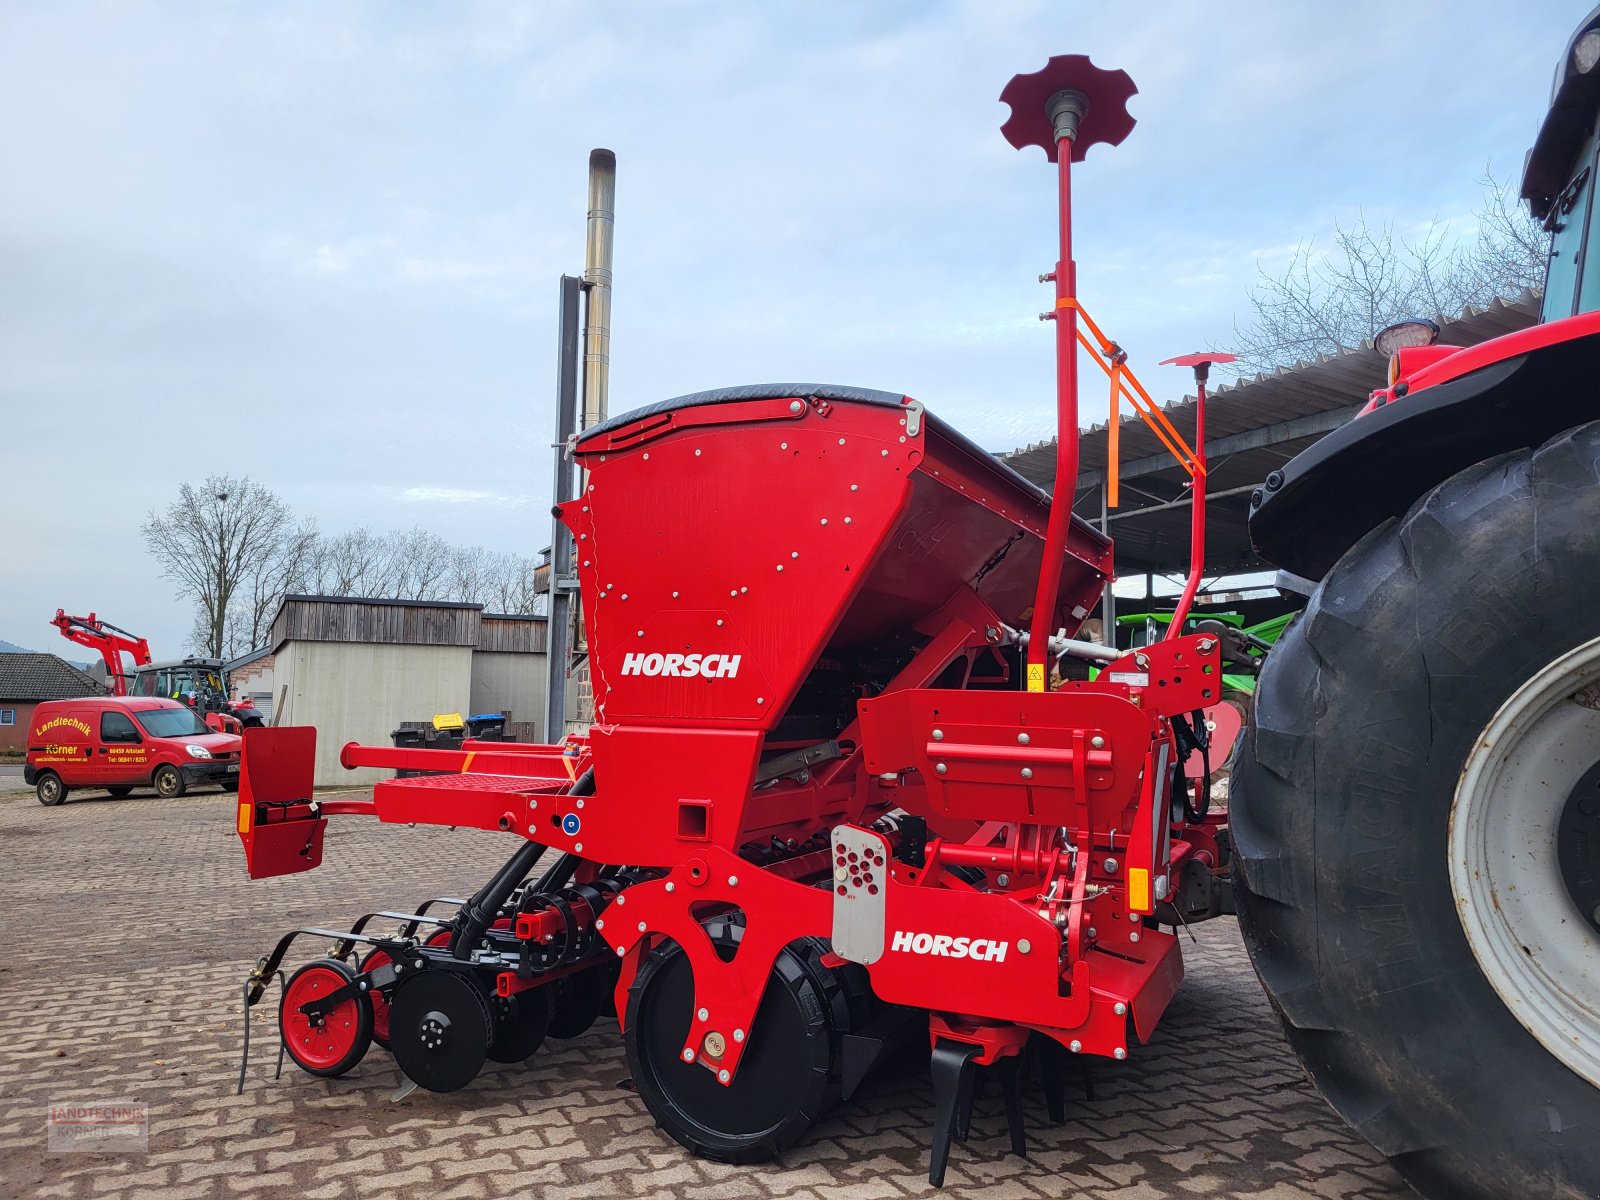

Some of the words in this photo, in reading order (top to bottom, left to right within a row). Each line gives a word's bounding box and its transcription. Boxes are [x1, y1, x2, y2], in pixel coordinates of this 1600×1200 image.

[621, 652, 742, 678] HORSCH
[36, 717, 91, 736] Landtechnik
[891, 930, 1009, 963] HORSCH
